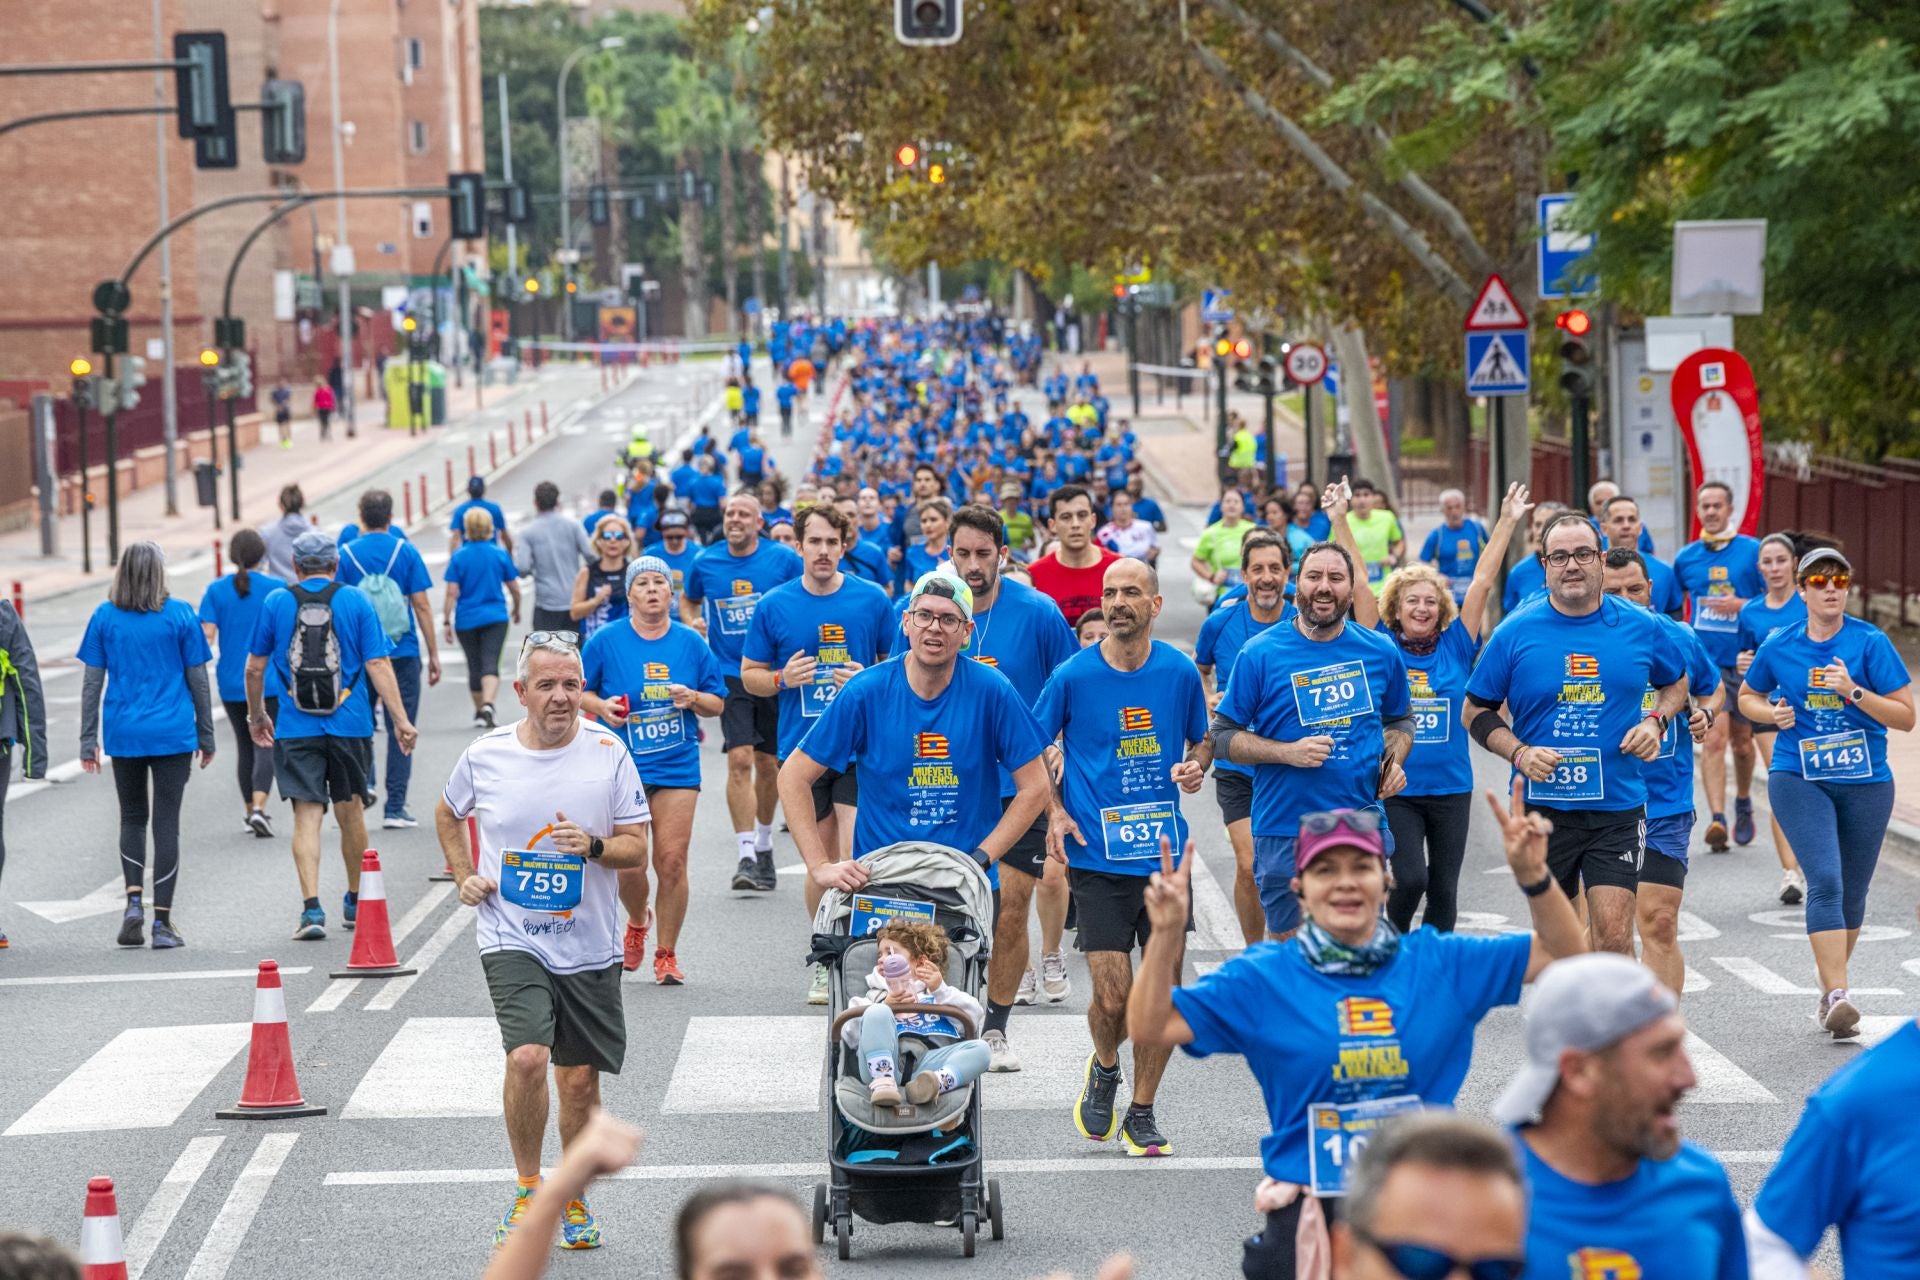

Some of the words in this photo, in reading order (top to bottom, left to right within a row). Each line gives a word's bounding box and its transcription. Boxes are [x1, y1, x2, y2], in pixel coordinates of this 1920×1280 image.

[1295, 354, 1320, 371] 30
[727, 606, 754, 622] 365
[813, 684, 837, 702] 42
[1308, 681, 1355, 707] 730
[635, 719, 680, 740] 1095
[1415, 713, 1439, 728] 29
[1809, 747, 1864, 768] 1143
[913, 763, 953, 777] MUÉVETE
[916, 775, 959, 786] VALENCIA
[1120, 821, 1163, 842] 637
[516, 871, 568, 893] 759
